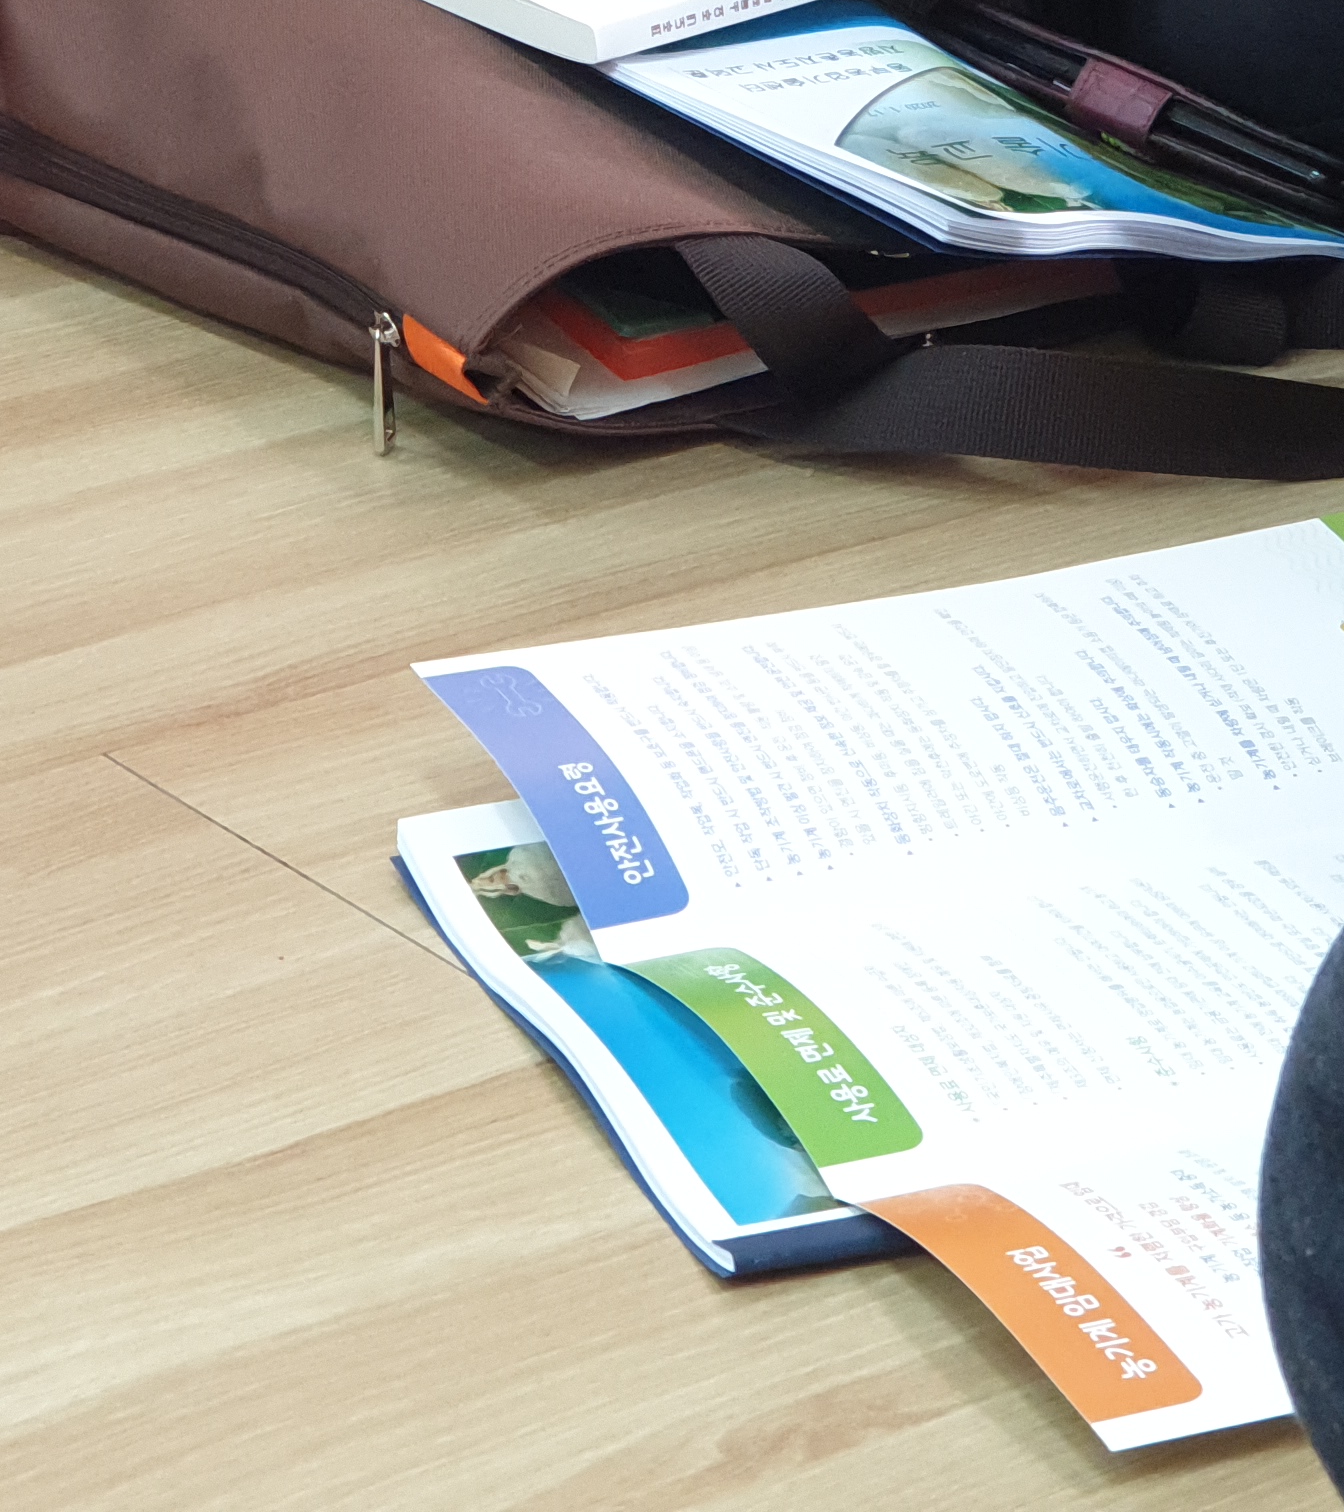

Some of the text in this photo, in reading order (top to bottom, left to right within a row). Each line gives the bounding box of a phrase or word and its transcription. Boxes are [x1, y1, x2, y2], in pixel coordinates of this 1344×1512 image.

[753, 43, 906, 75] 지방농촌지도사
[739, 62, 913, 94] 동부농업기술센터
[886, 134, 1091, 167] 기술 교육
[706, 776, 734, 806] 반드시
[1169, 760, 1200, 792] 농기계
[559, 762, 655, 885] 안전사용요령
[733, 821, 752, 843] 작업
[771, 830, 801, 864] 농기계
[802, 826, 830, 859] 농기계
[704, 963, 876, 1121] 사용료 면제 및 준수사항
[1008, 1246, 1157, 1380] 농기계 임대사업
